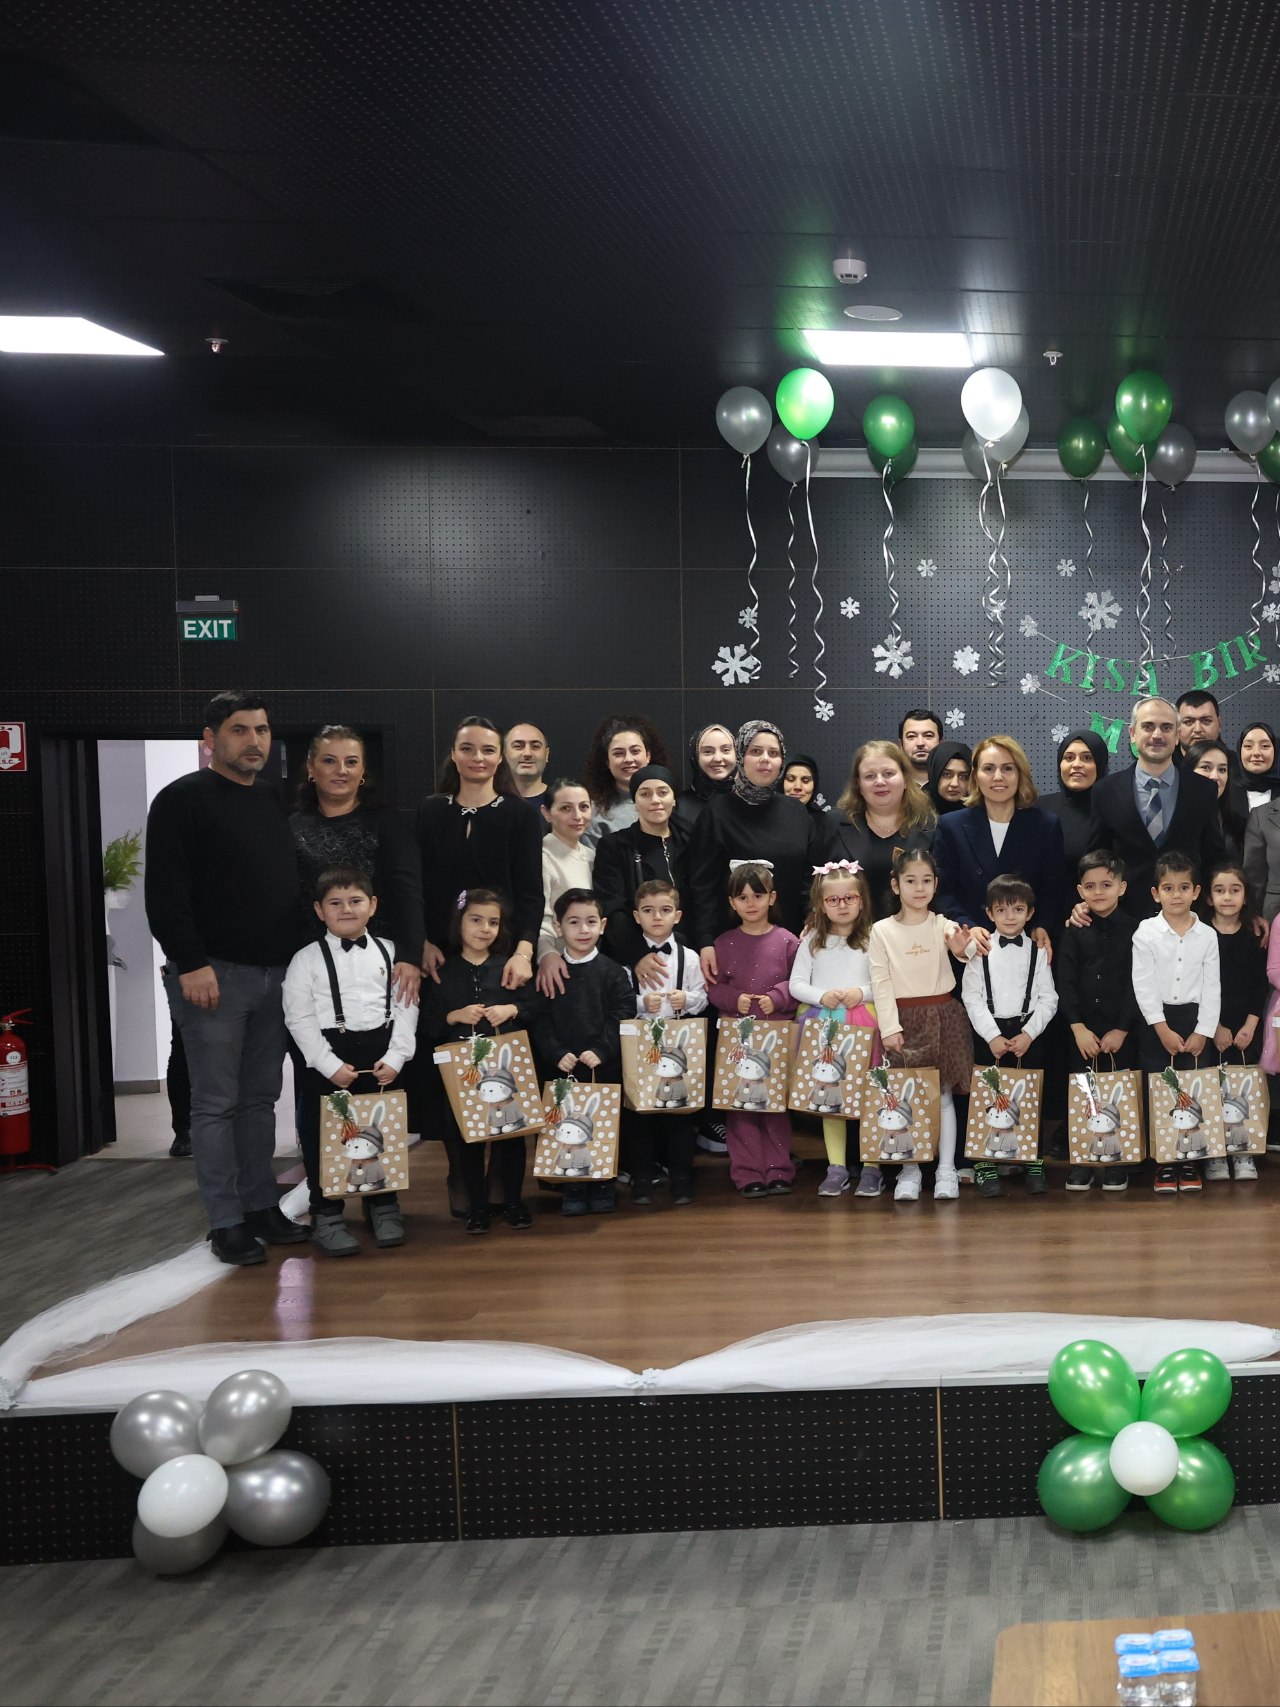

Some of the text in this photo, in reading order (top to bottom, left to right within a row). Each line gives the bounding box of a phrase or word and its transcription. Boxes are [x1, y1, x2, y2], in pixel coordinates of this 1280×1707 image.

[184, 620, 231, 638] EXIT
[1043, 642, 1160, 697] KISA
[1089, 711, 1140, 758] M
